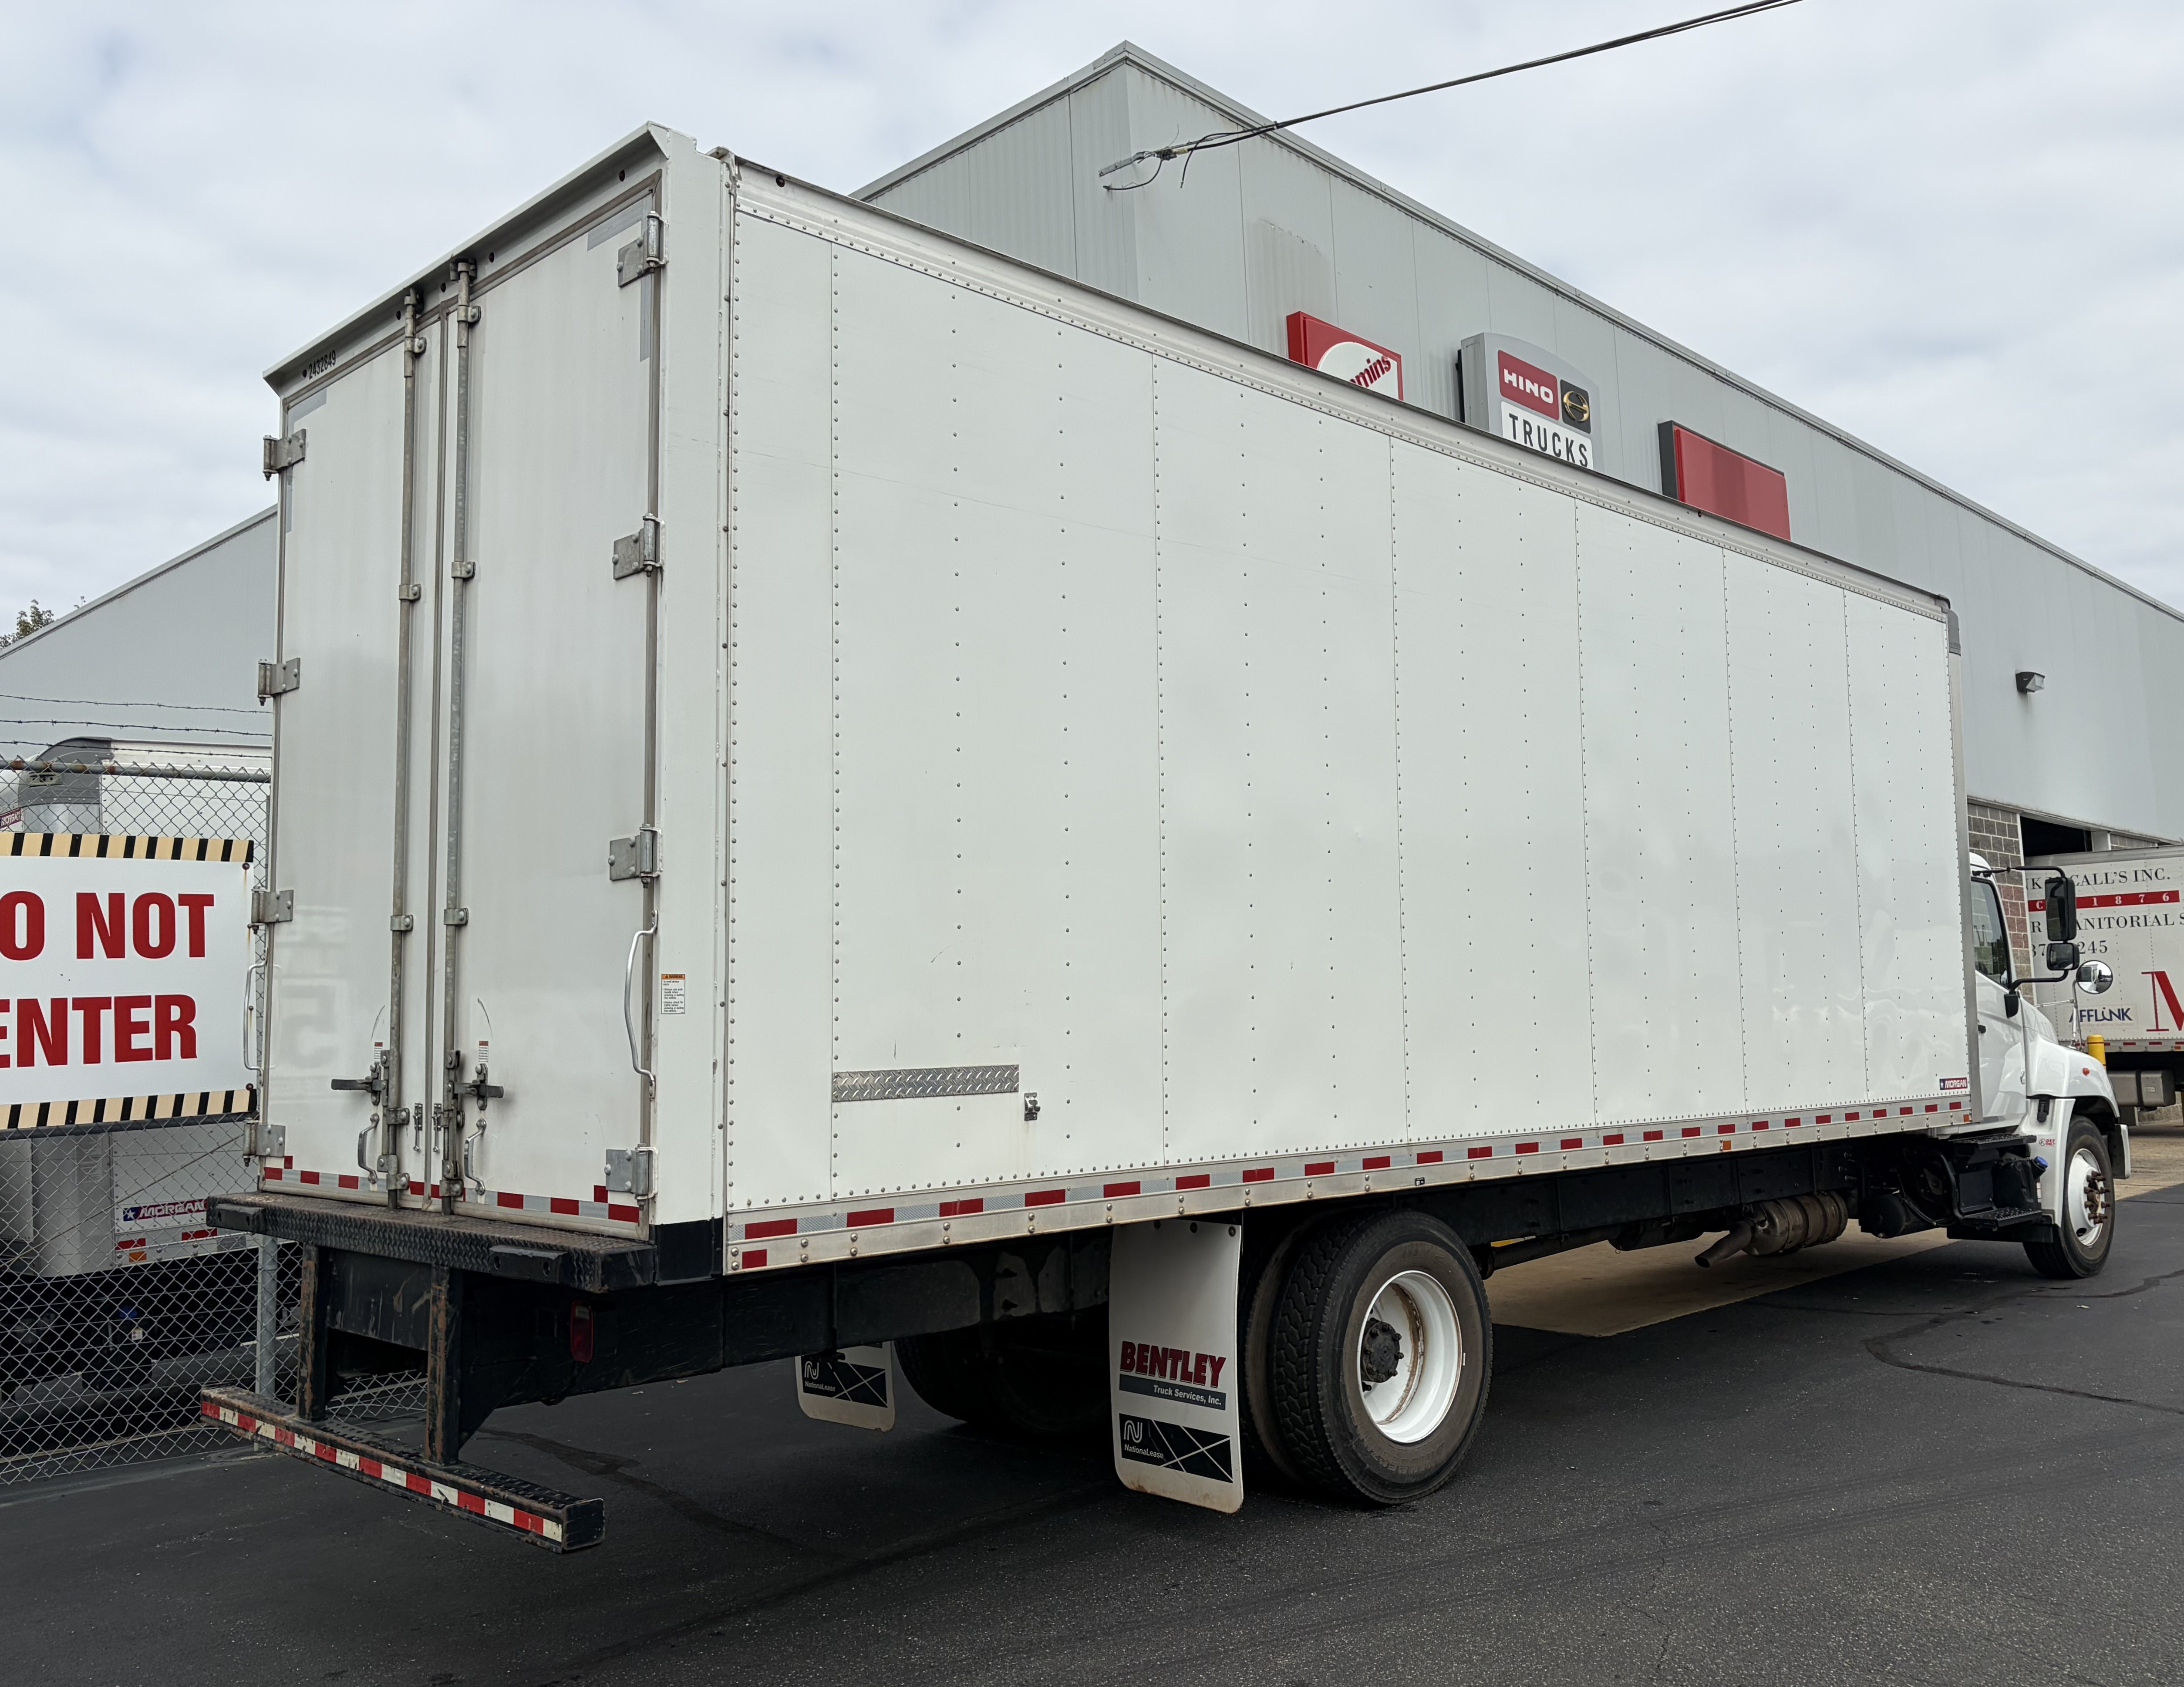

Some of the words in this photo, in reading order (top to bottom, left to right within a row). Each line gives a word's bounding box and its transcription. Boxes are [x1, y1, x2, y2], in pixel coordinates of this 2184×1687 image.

[309, 350, 336, 380] 2432849
[1503, 368, 1553, 404] HINO
[1509, 413, 1588, 468] TRUCKS
[2133, 868, 2171, 882] INC.
[76, 892, 214, 959] NOT
[0, 994, 197, 1068] NTER
[1945, 1079, 1967, 1088] MORGAN
[139, 1202, 205, 1218] MORGAN
[1120, 1340, 1227, 1388] BENTLEY
[1153, 1385, 1173, 1396] Truck
[1174, 1389, 1206, 1404] Services,
[1208, 1395, 1221, 1405] Inc.
